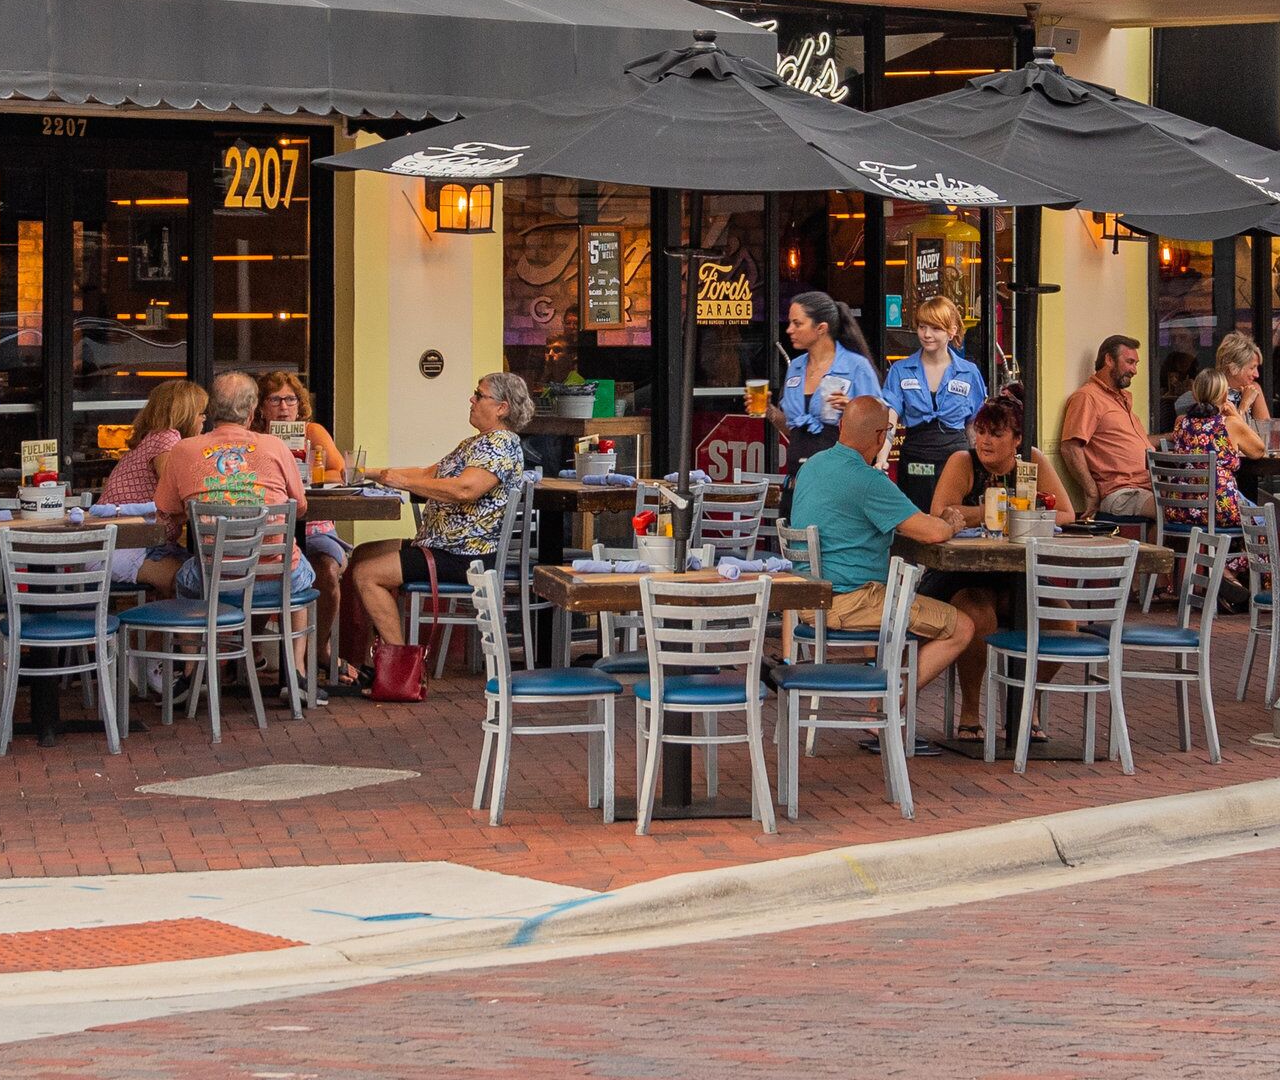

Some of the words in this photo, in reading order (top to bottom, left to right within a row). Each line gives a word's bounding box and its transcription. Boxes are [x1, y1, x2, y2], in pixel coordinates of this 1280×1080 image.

[42, 116, 87, 137] 2207
[224, 146, 300, 210] 2207
[916, 252, 941, 271] HAPPY
[696, 303, 751, 316] GARAGE
[270, 425, 304, 435] FUELING
[22, 442, 56, 456] FUELING
